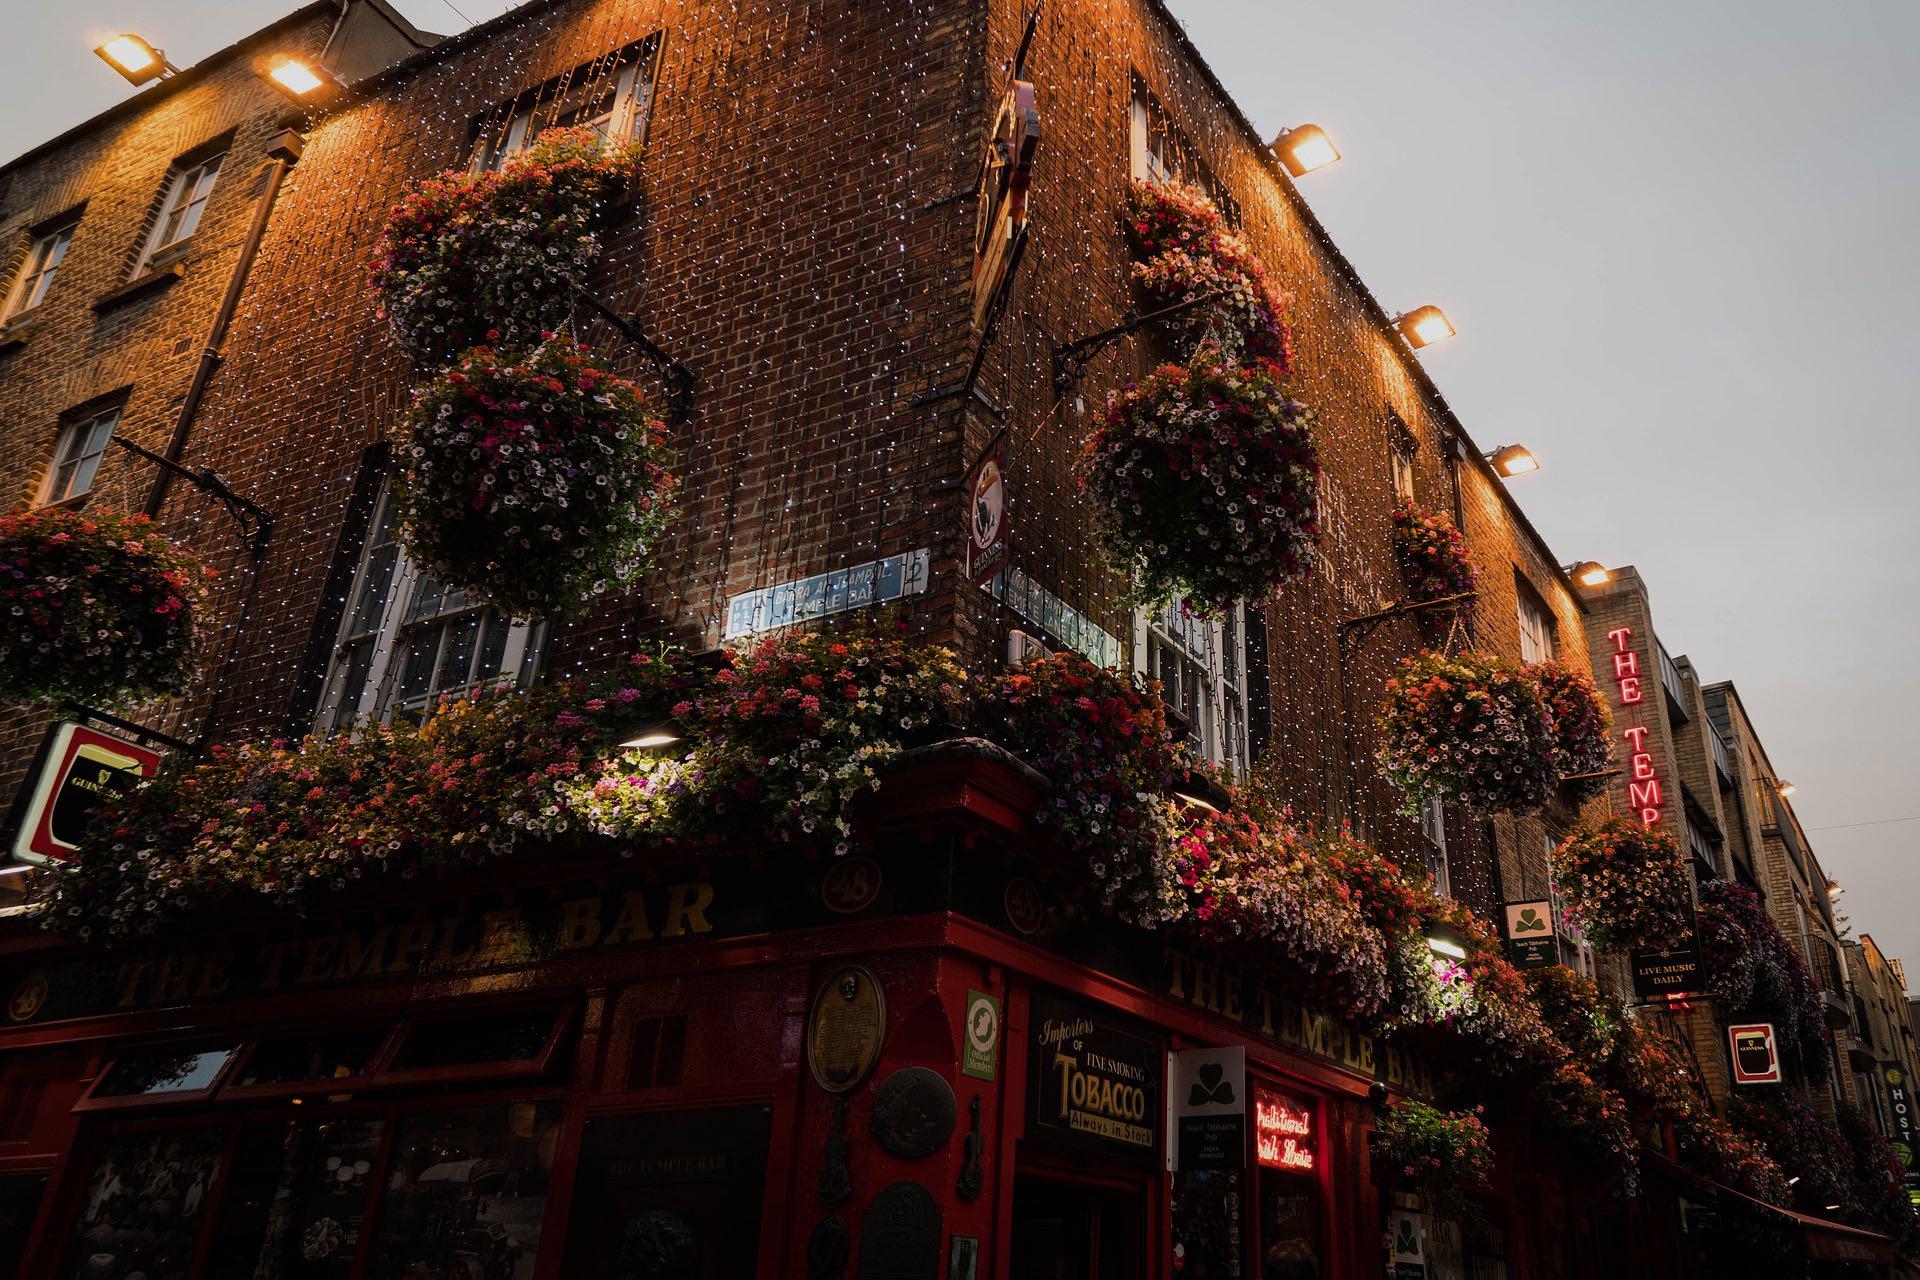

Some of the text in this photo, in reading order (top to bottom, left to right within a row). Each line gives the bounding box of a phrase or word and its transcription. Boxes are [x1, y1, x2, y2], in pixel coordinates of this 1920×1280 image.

[787, 593, 841, 620] TEMPLE
[1608, 627, 1664, 824] THE TEMP
[831, 866, 870, 903] 48
[1014, 887, 1036, 921] 48
[115, 879, 717, 1008] THE TEMPLE BAR
[1639, 963, 1696, 976] LIVE MUSIC
[1653, 974, 1684, 986] DAILY
[1164, 951, 1244, 1021] THE
[1257, 987, 1376, 1076] TEMPLE
[1038, 1017, 1095, 1051] Importers
[1073, 1039, 1084, 1051] OF
[1086, 1051, 1145, 1082] FINE SMOKING
[1054, 1052, 1145, 1122] TOBACCO
[1071, 1111, 1151, 1145] Always in Stock
